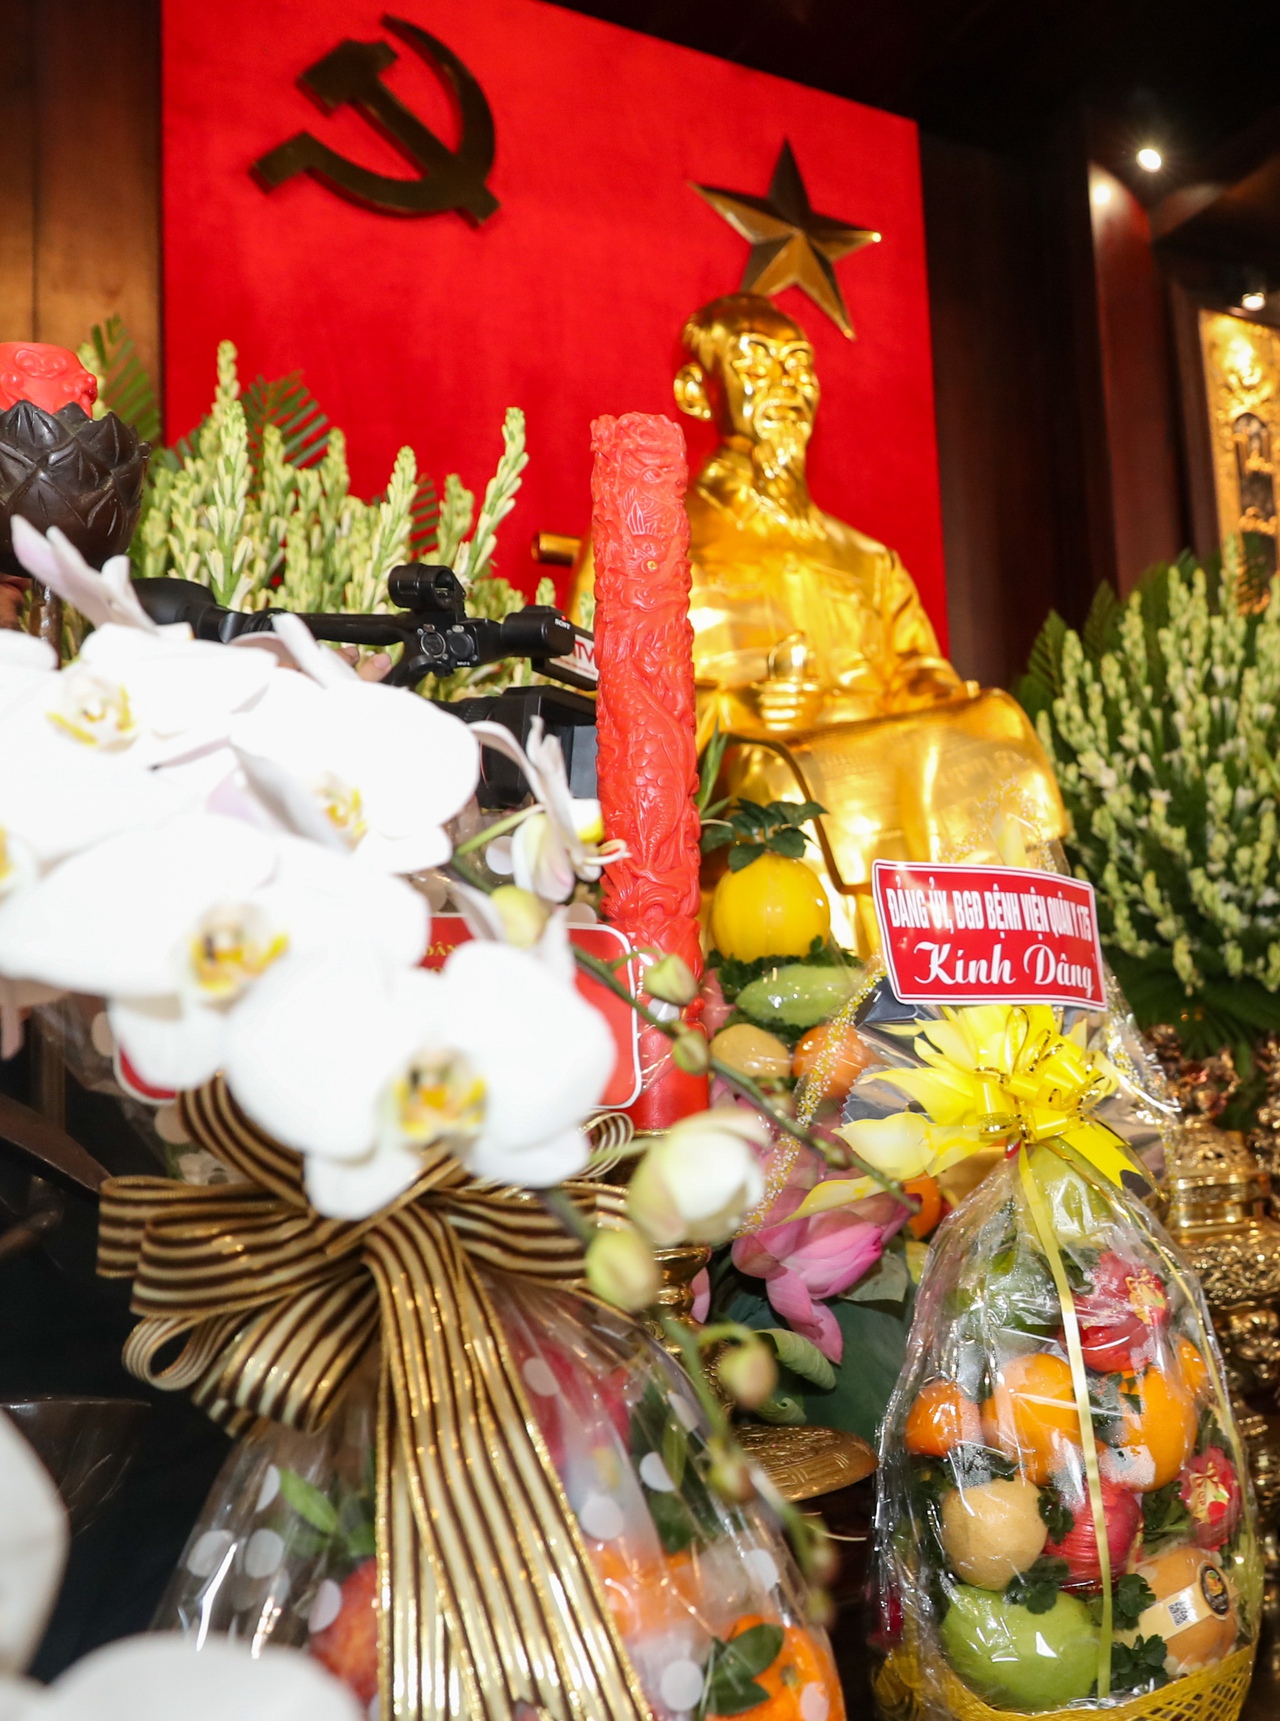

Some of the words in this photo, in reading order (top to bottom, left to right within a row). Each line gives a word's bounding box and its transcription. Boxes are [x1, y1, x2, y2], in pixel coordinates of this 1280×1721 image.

[886, 875, 930, 929] ĐẢNG
[952, 890, 985, 930] BGĐ
[984, 883, 1023, 939] BỆNH
[1020, 886, 1050, 940] VIỆN
[1023, 944, 1094, 998] Dâng
